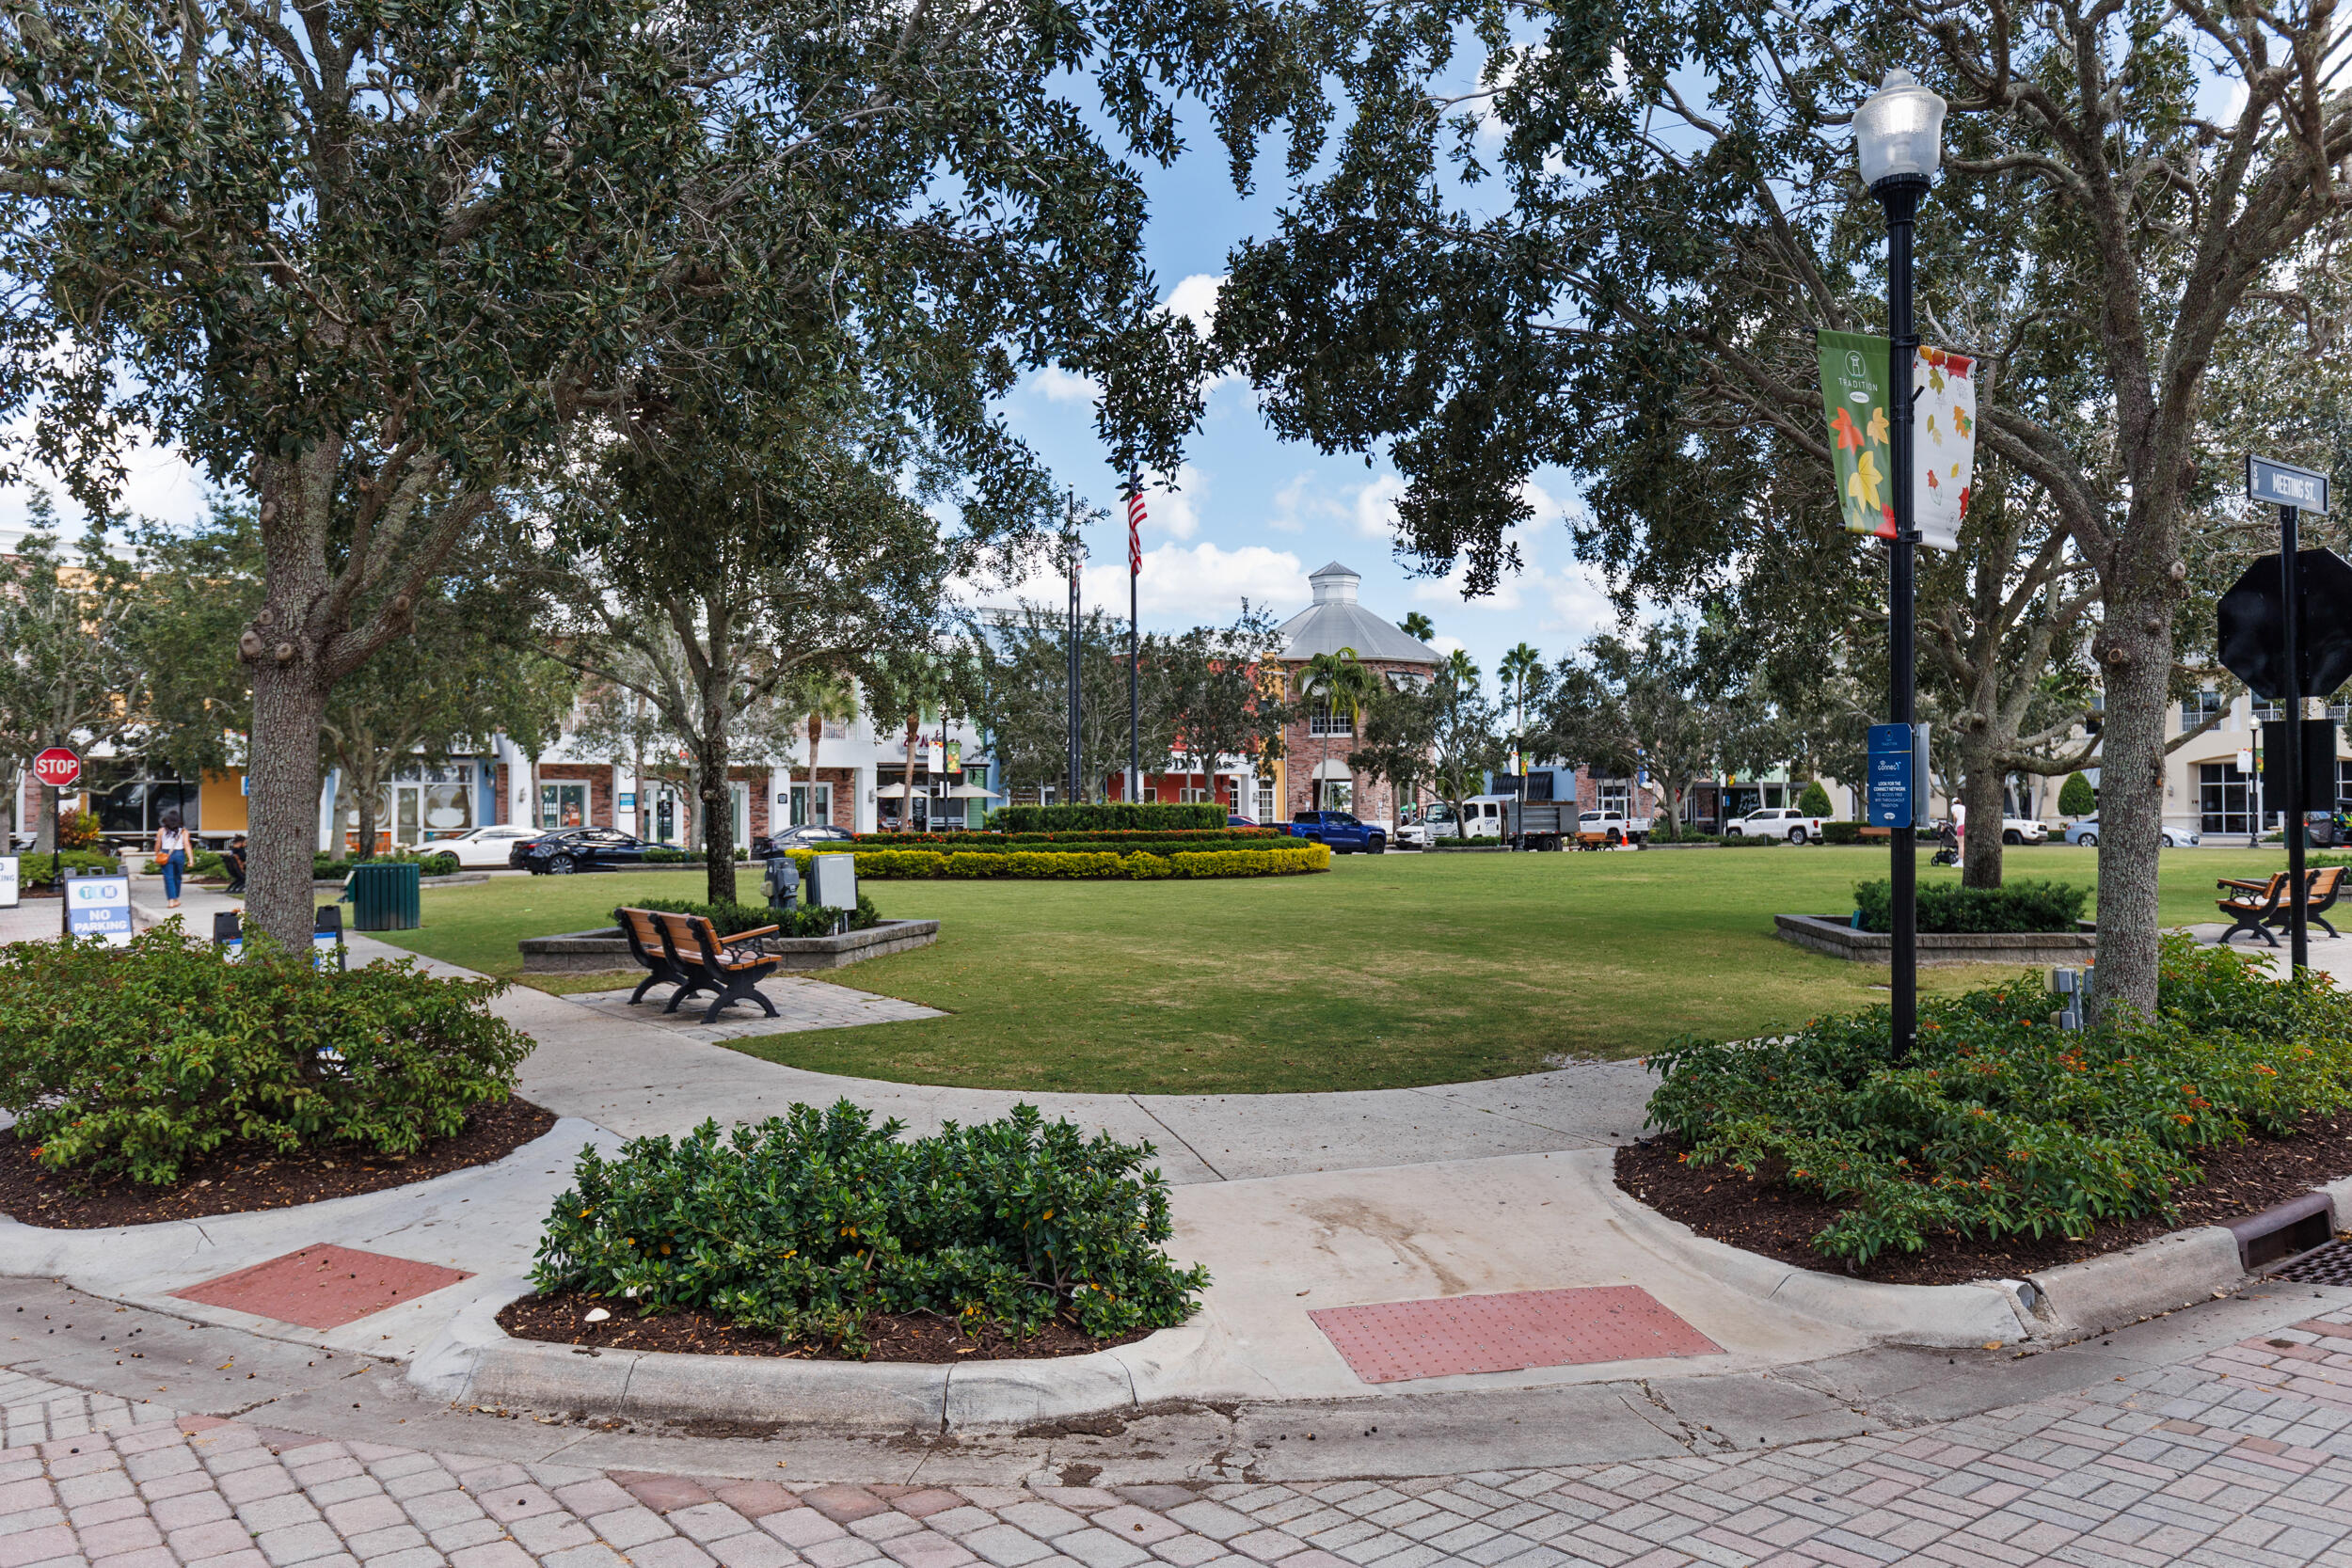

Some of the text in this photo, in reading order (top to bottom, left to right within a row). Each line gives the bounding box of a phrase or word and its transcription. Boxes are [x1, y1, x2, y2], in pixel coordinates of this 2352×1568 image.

[1838, 378, 1878, 392] TRADITION
[2273, 472, 2316, 502] MEETING ST.
[37, 759, 78, 774] STOP
[89, 910, 111, 921] NO
[74, 920, 128, 932] PARKING
